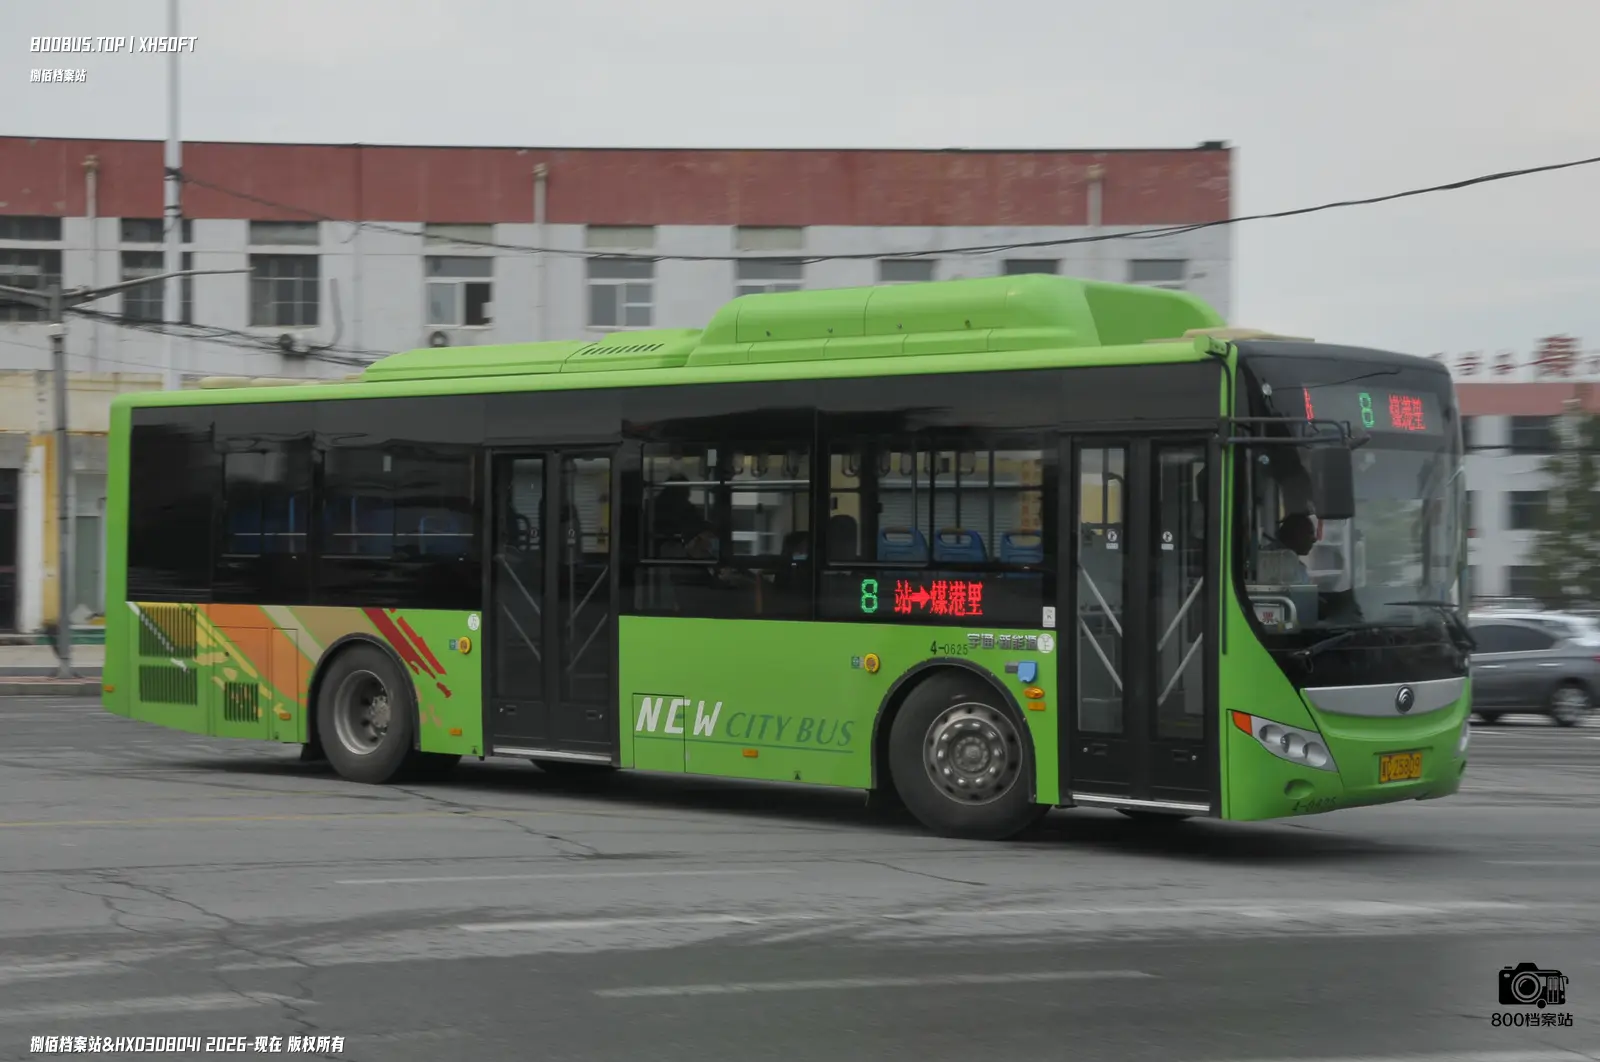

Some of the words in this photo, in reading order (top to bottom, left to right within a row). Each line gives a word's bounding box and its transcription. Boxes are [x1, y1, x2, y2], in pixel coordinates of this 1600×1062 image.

[861, 579, 878, 613] 8
[930, 641, 969, 655] 4-0625
[635, 697, 723, 736] NEW
[726, 712, 792, 741] CITY
[796, 717, 855, 746] BUS
